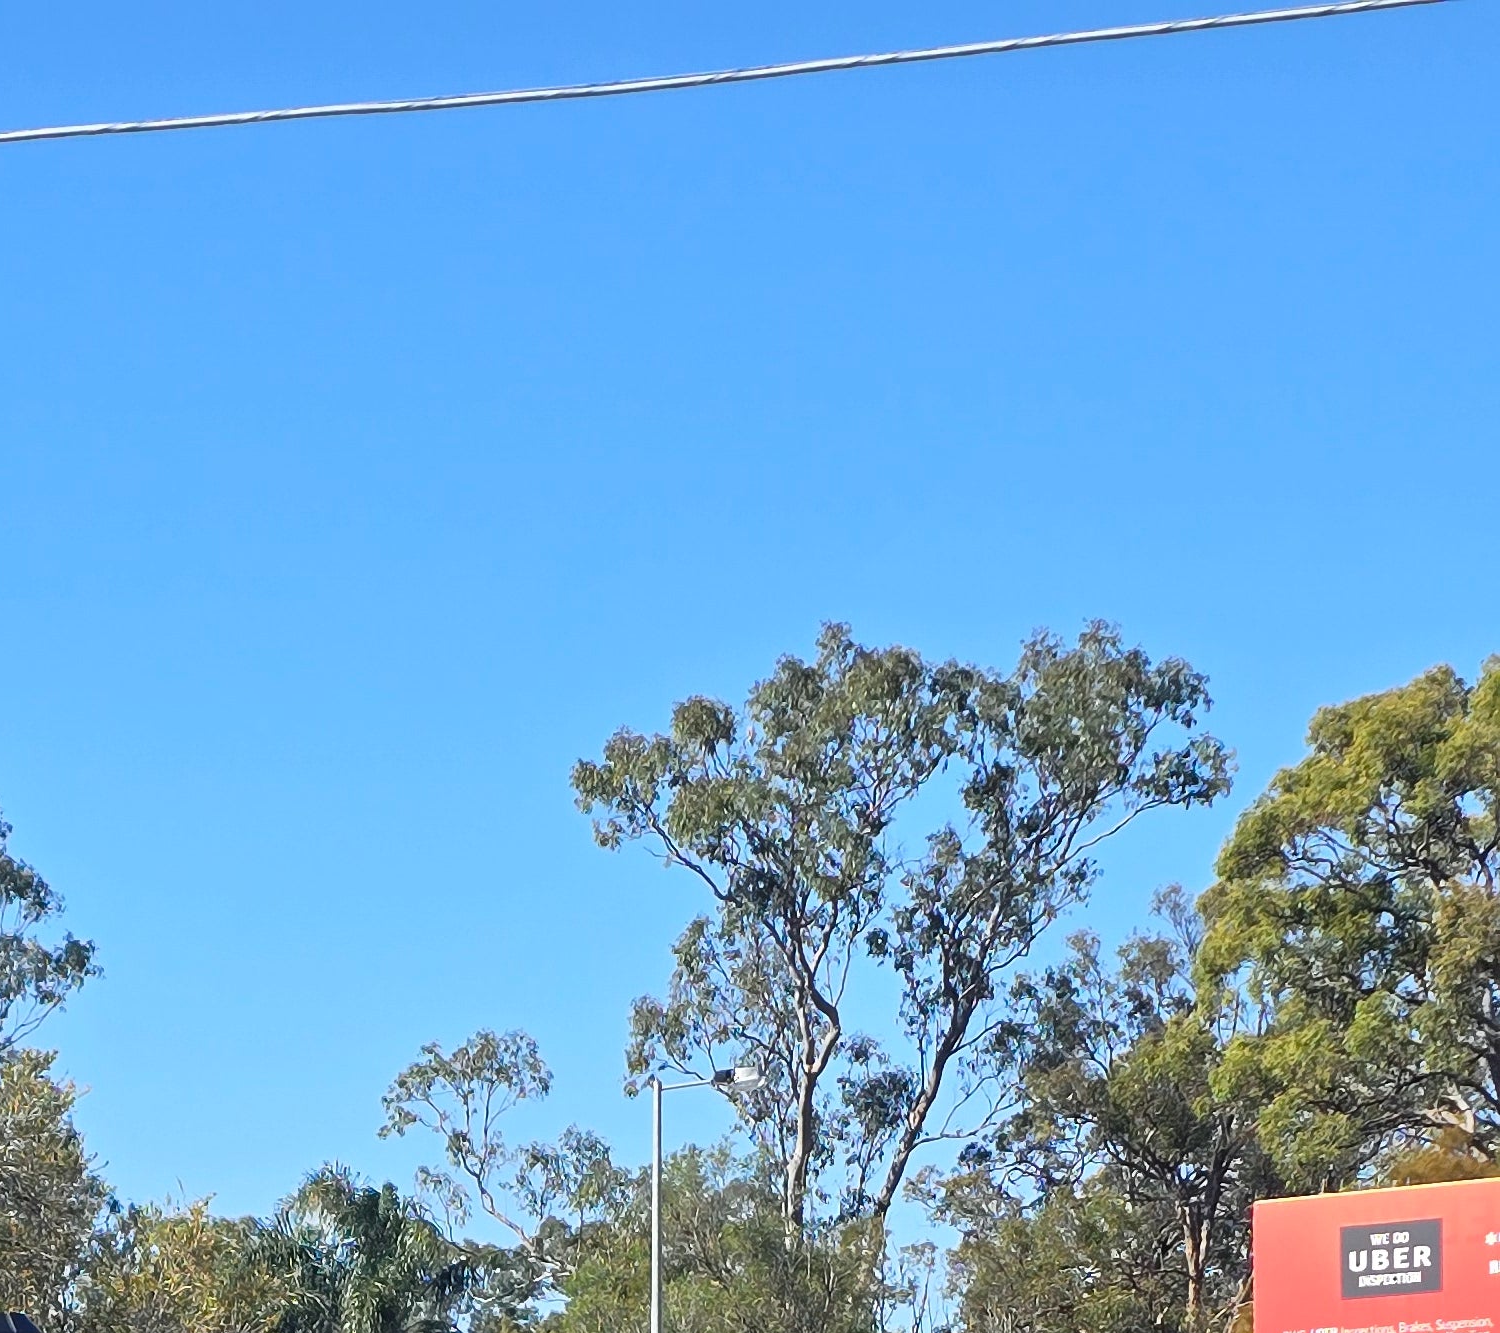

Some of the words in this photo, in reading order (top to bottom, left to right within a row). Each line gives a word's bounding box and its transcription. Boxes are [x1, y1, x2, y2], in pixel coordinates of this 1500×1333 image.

[1370, 1233, 1389, 1245] WE
[1393, 1231, 1409, 1244] DO
[1349, 1245, 1432, 1272] UBER
[1359, 1271, 1421, 1287] INSPECTION
